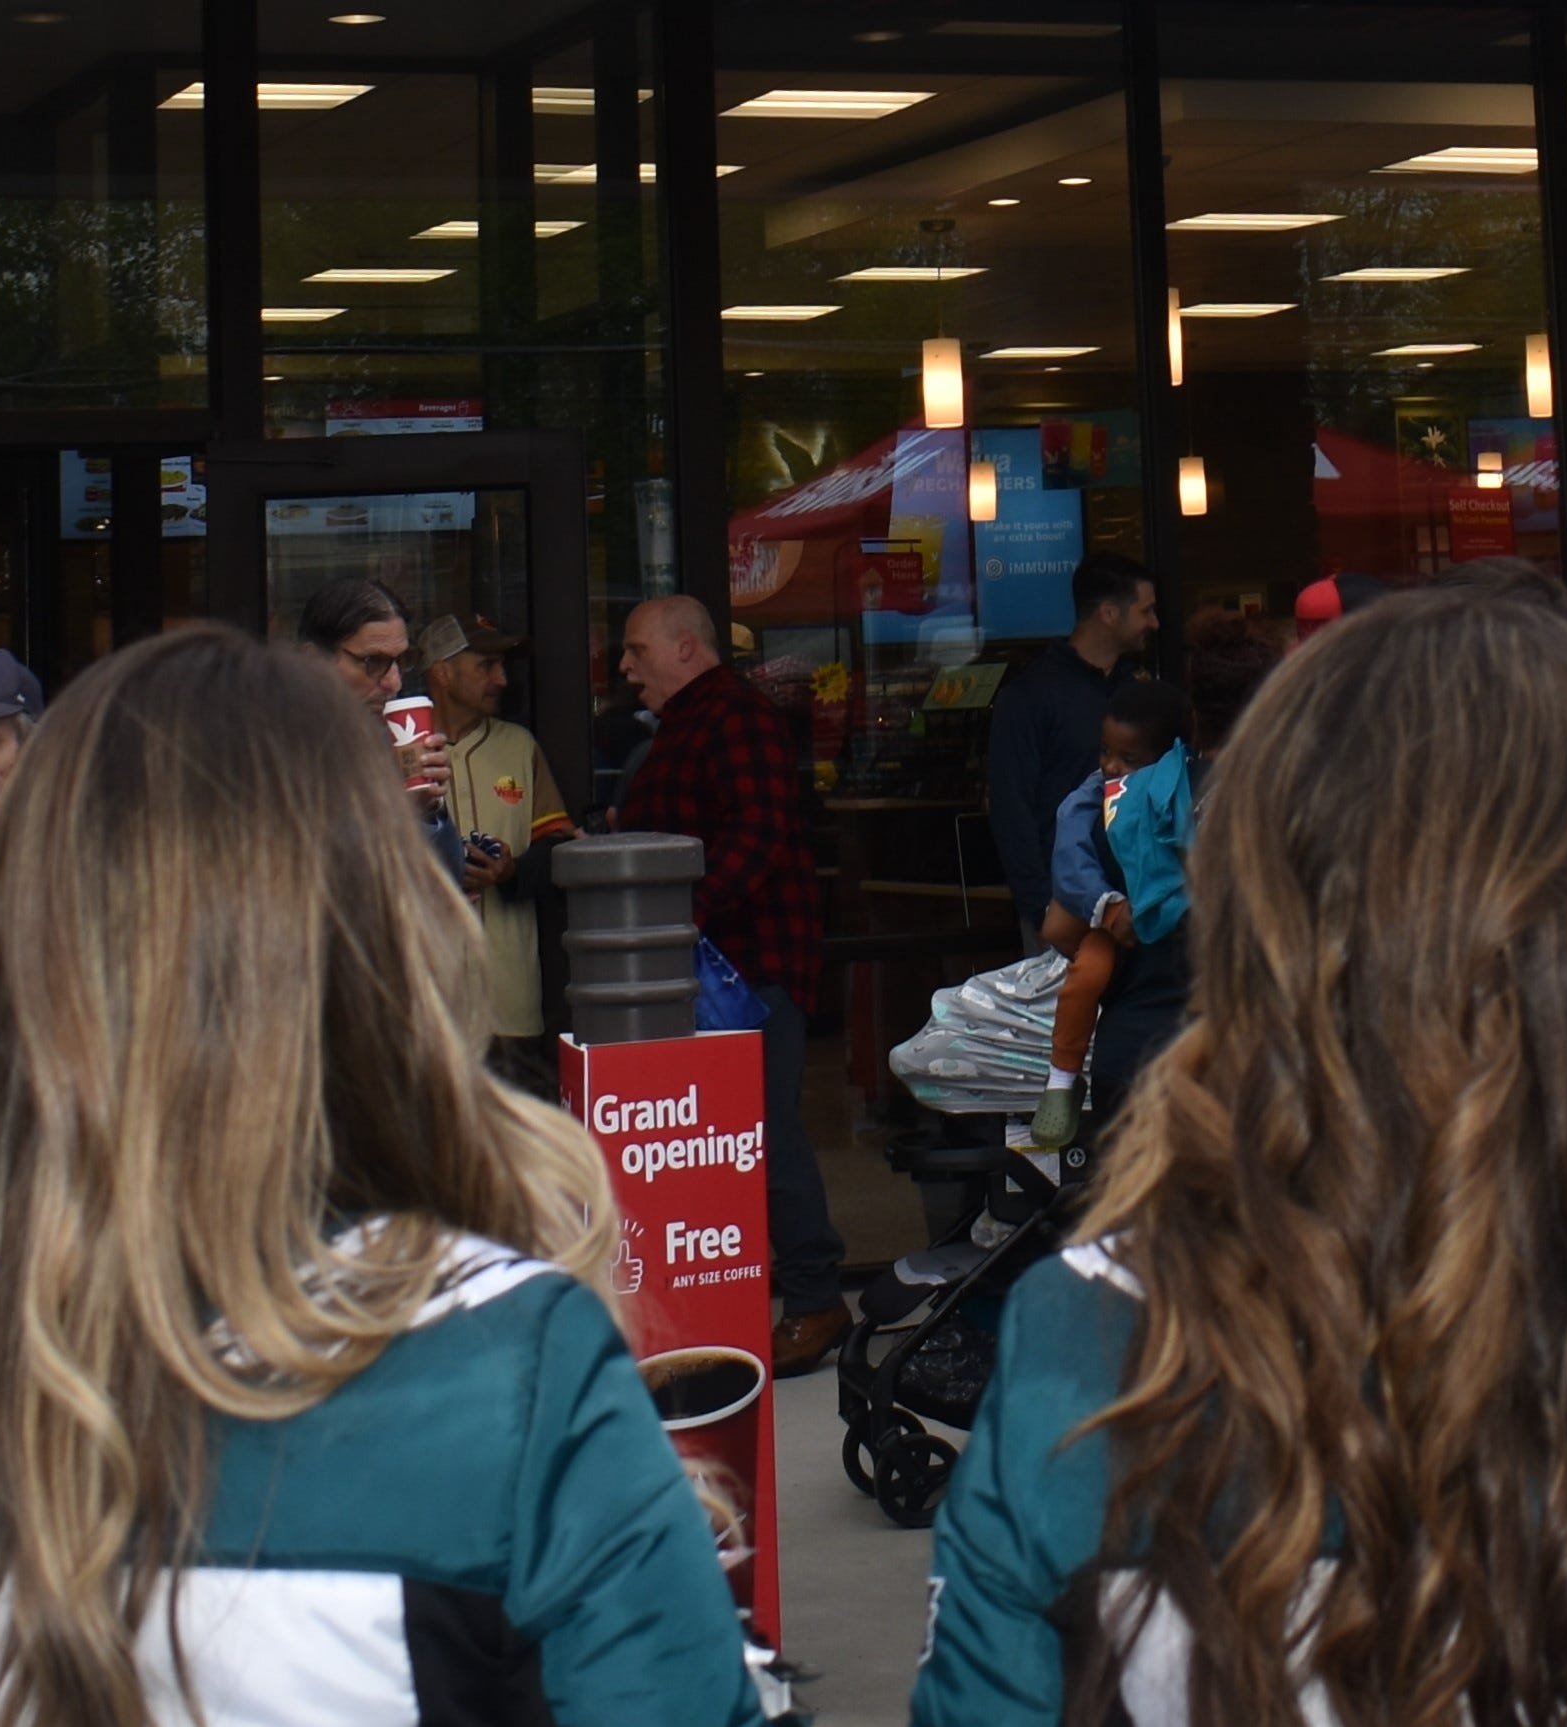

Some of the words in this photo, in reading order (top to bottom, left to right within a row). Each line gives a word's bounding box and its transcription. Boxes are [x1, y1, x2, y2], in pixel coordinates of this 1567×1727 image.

[914, 475, 1036, 492] RECHERS
[1449, 498, 1467, 512] Self
[1469, 498, 1510, 512] Checkout
[887, 558, 918, 569] Order
[892, 570, 917, 580] Here
[593, 1083, 698, 1135] Grand
[621, 1121, 764, 1183] opening!
[665, 1221, 742, 1265] Free
[672, 1274, 696, 1289] ANY
[698, 1271, 722, 1286] SIZE
[723, 1264, 763, 1282] COFFEE
